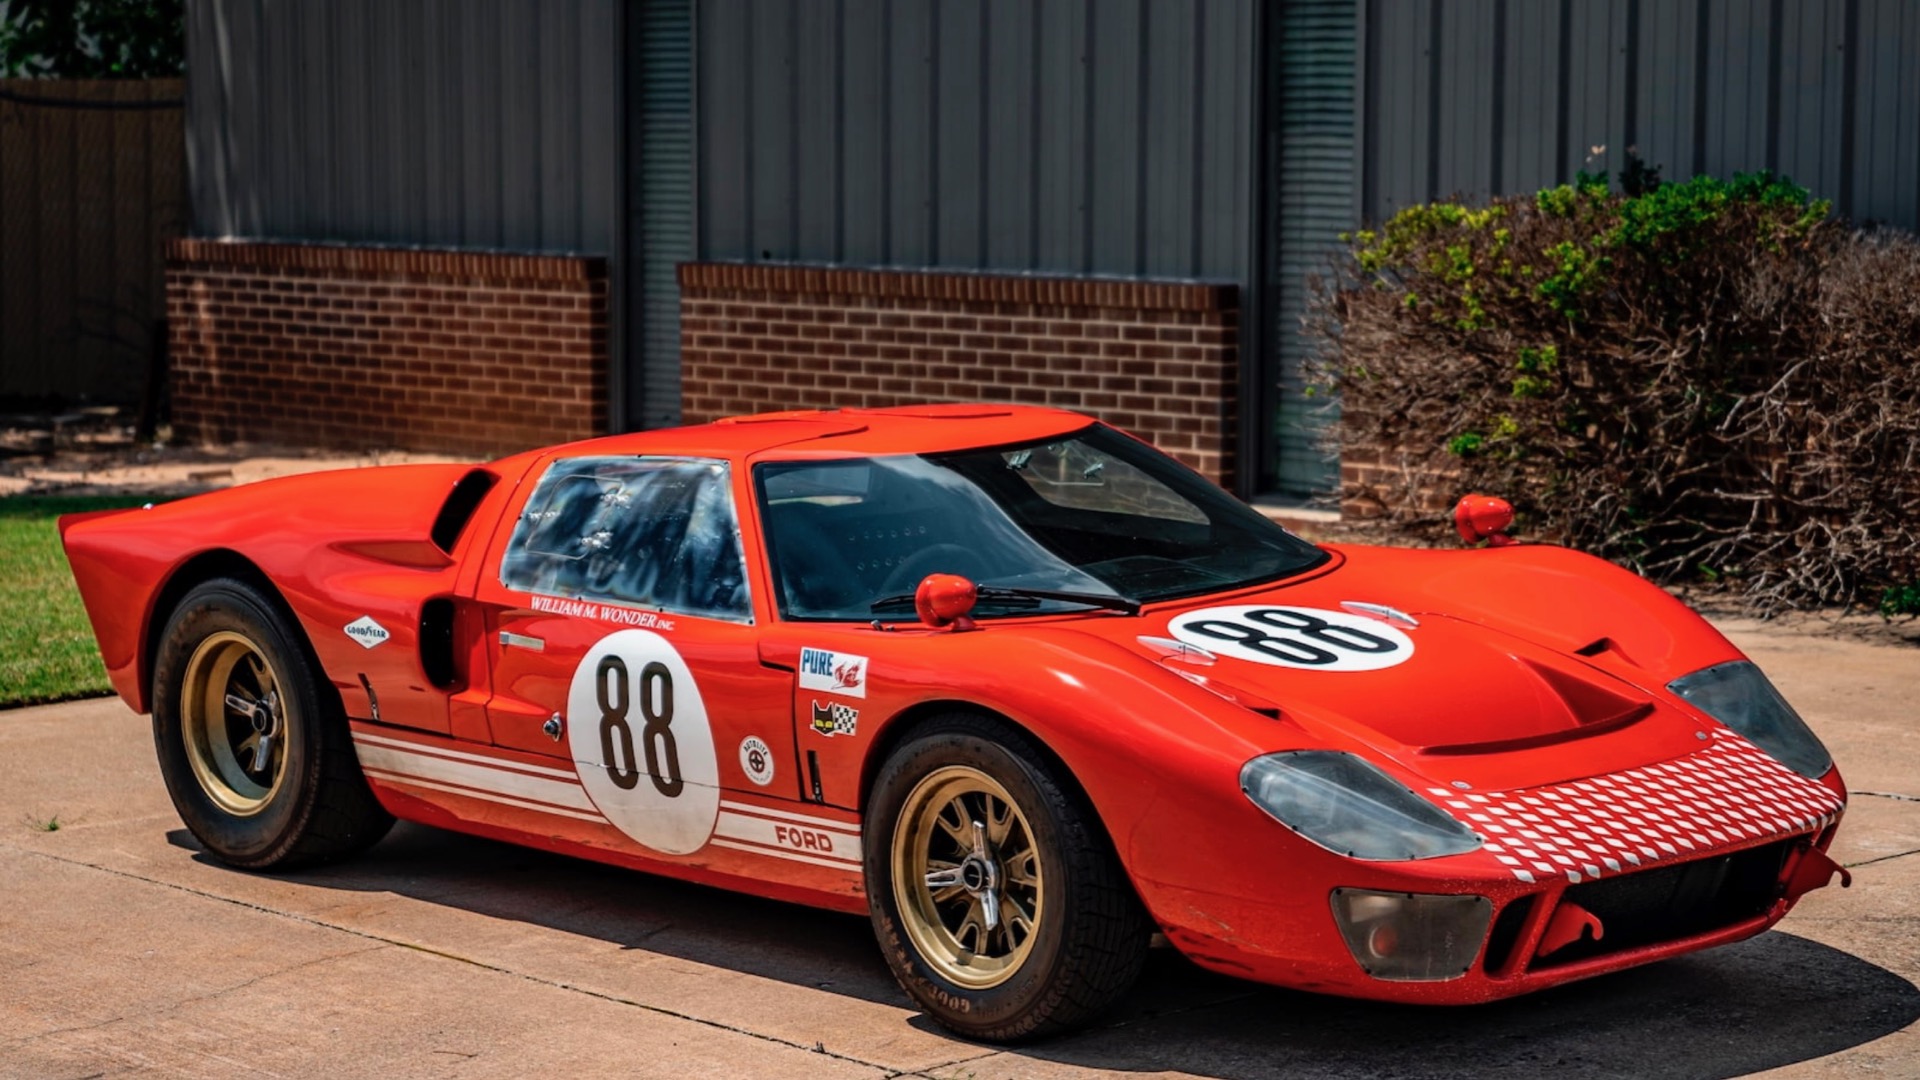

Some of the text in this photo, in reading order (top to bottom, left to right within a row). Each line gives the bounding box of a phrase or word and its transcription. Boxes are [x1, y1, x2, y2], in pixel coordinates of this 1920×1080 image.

[531, 596, 582, 617] WILLIAM
[600, 606, 657, 628] WONDER
[347, 626, 386, 638] GOODYEAR
[1182, 609, 1399, 665] 88
[802, 650, 833, 676] PURE
[596, 654, 684, 798] 88
[775, 825, 832, 852] FORD
